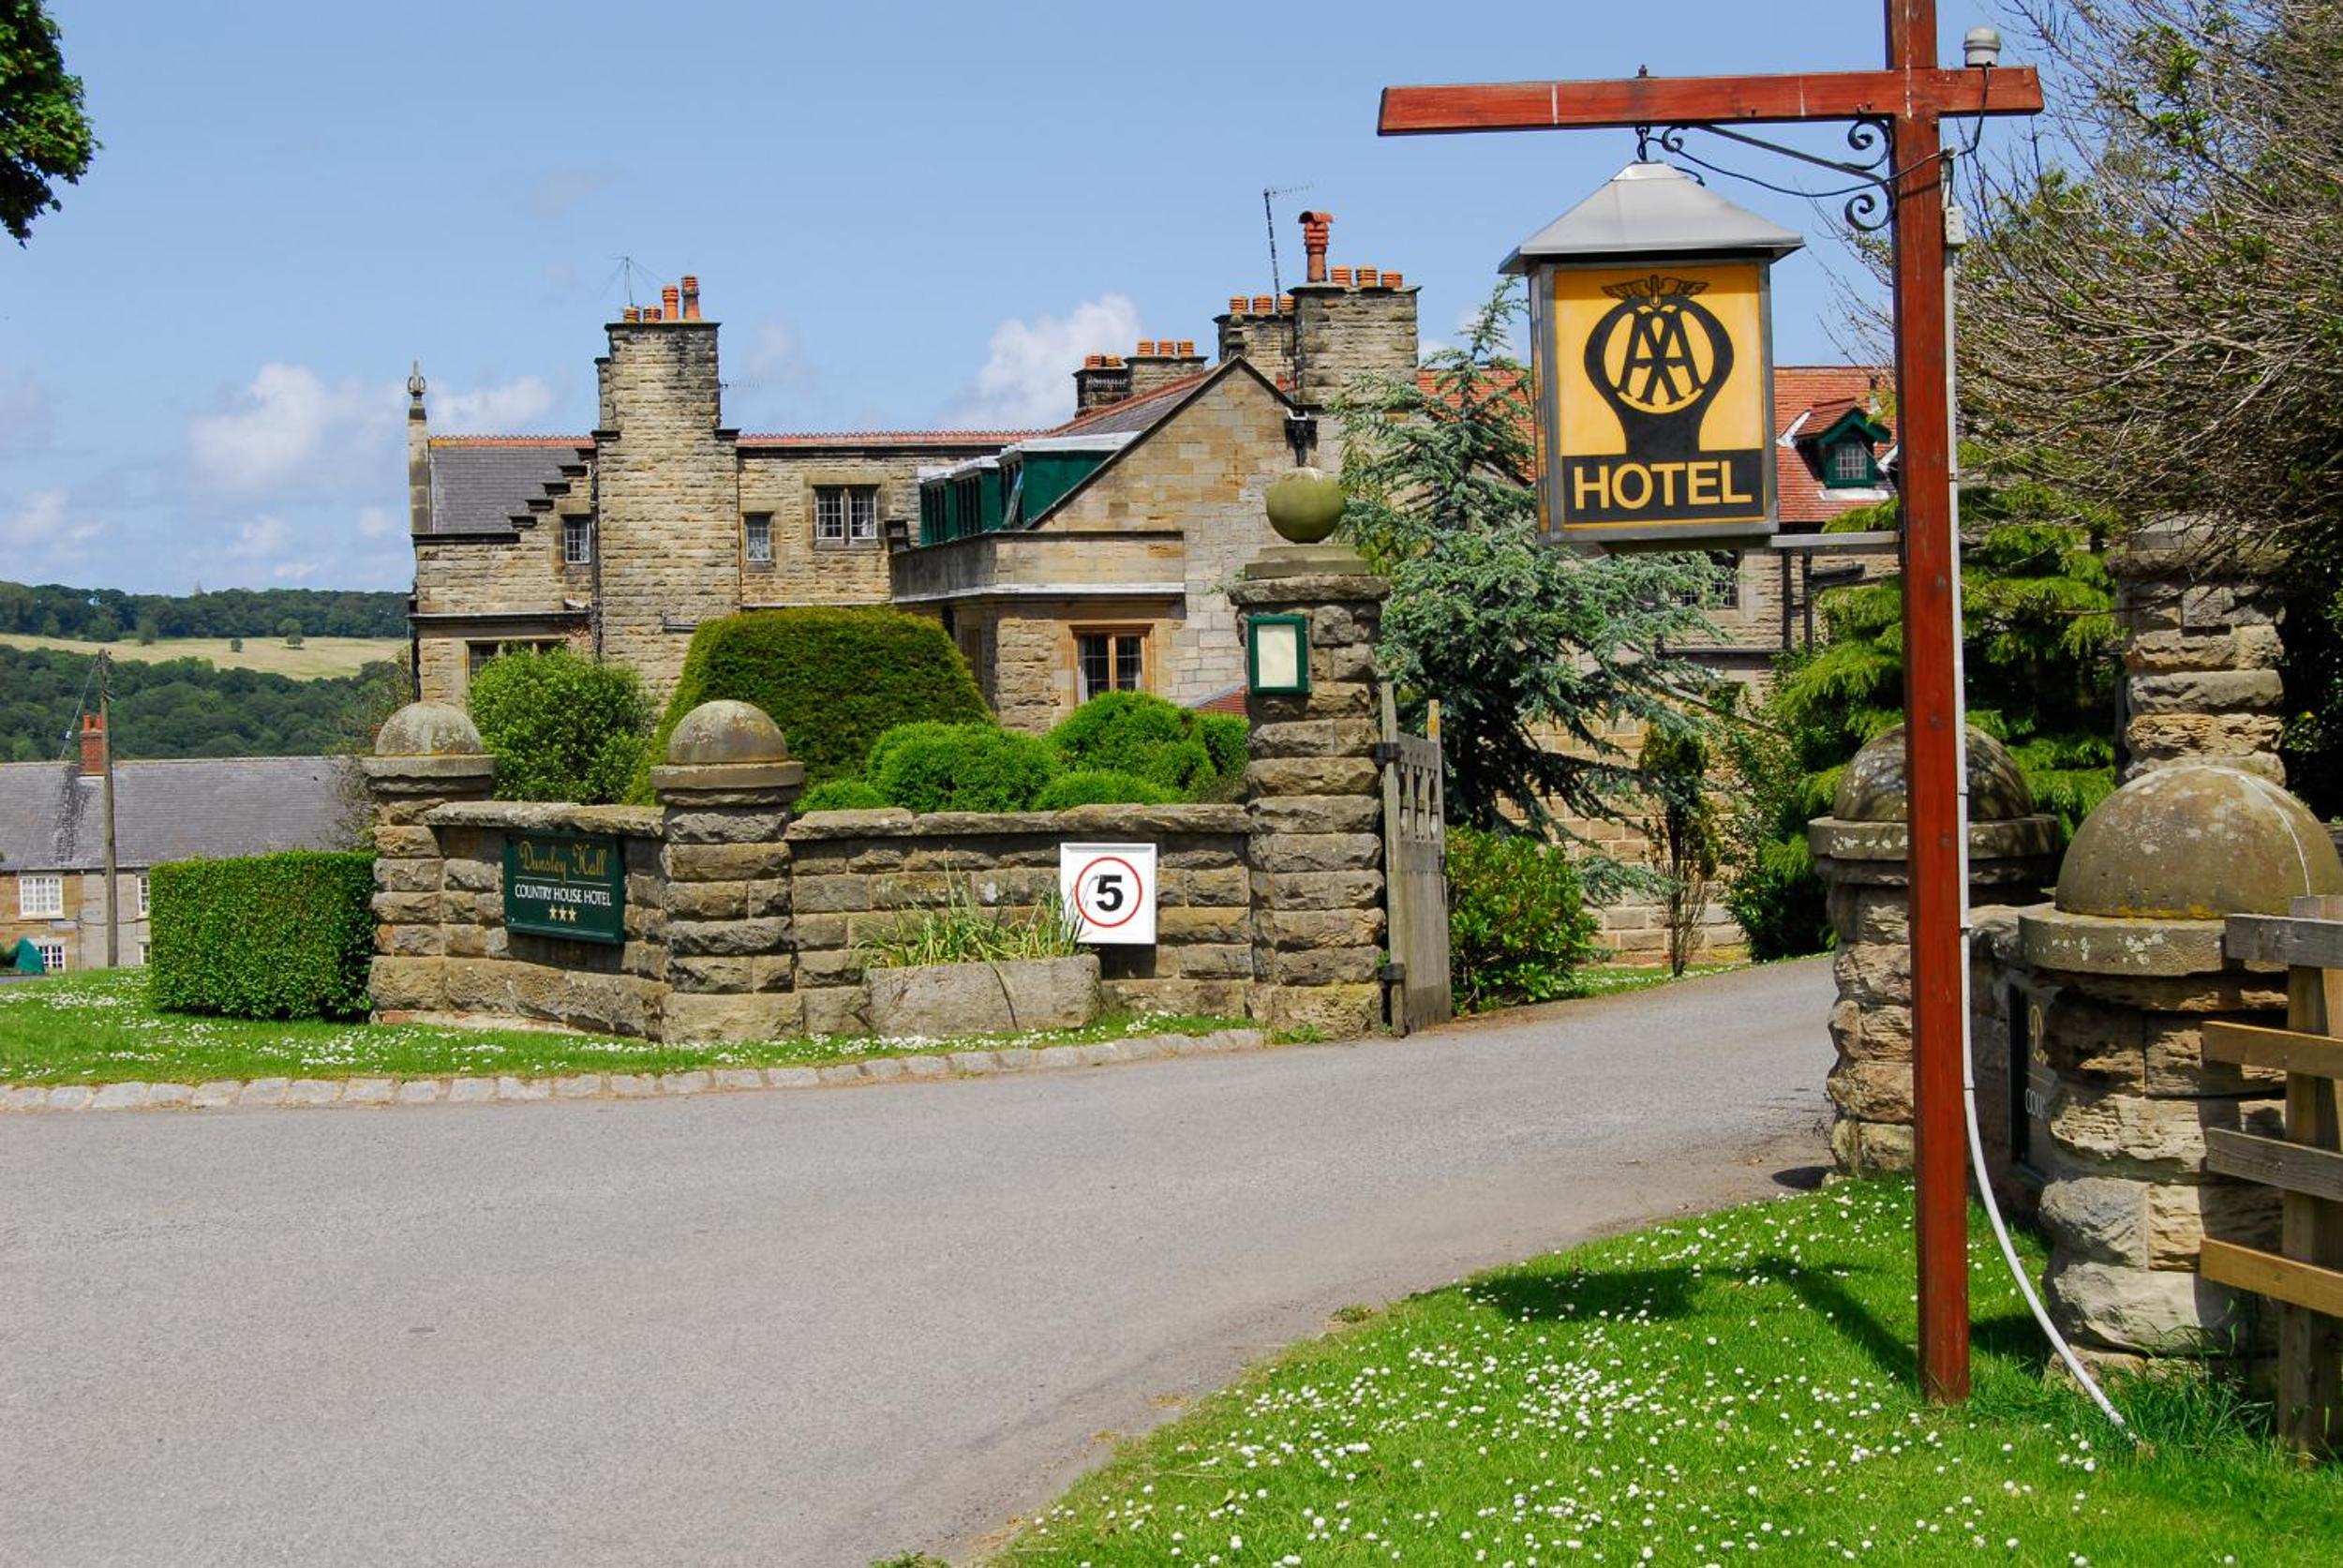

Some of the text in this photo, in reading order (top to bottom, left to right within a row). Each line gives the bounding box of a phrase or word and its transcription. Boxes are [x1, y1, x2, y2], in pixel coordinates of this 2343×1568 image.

[1617, 309, 1704, 406] AA
[1574, 460, 1753, 510] HOTEL
[519, 841, 607, 885] Dunsley Hall
[515, 884, 612, 906] COUNTRY HOUSE HOTEL
[1096, 874, 1124, 912] 5
